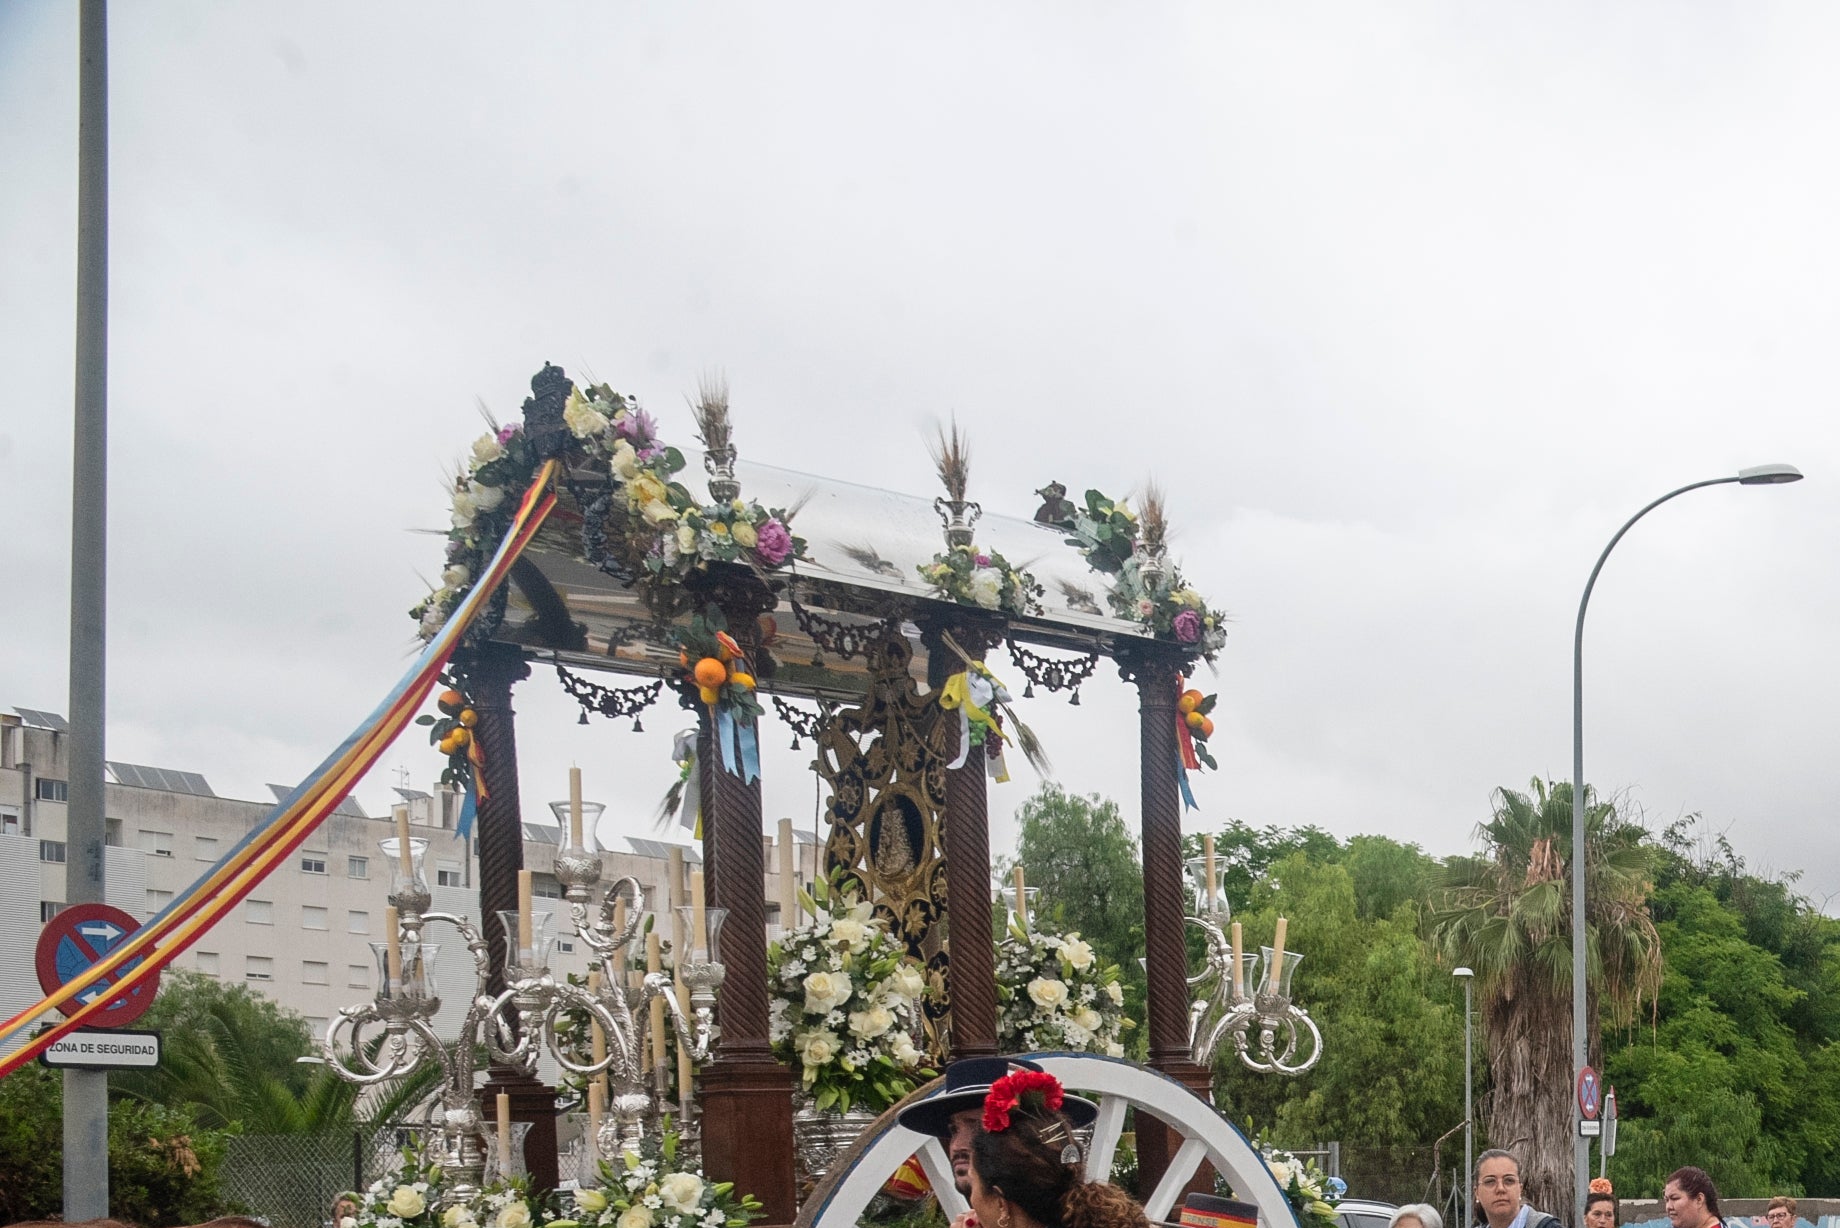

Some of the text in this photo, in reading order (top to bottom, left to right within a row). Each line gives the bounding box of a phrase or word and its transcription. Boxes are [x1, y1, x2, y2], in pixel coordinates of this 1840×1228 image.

[49, 1042, 156, 1056] ZONA DE SEGURIDAD
